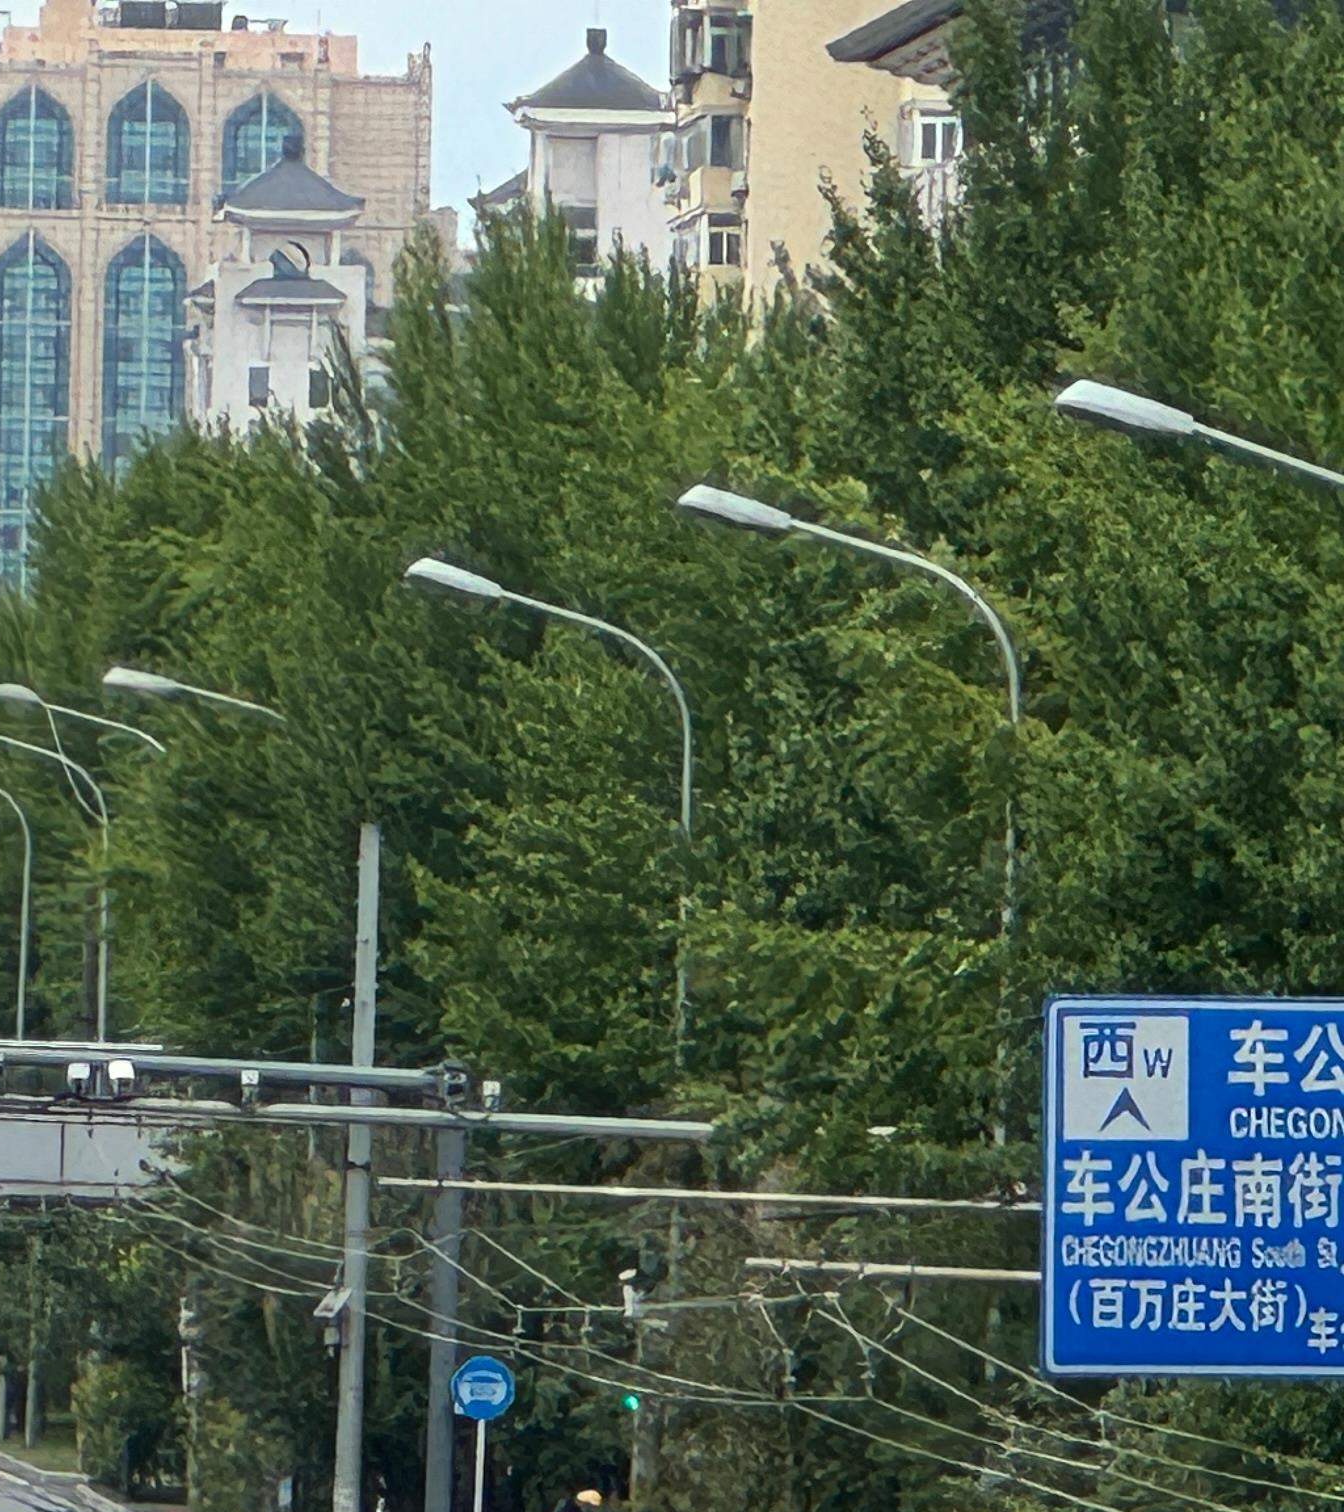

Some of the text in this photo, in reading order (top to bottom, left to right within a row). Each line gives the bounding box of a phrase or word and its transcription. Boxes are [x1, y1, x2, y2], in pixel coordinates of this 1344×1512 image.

[1079, 1021, 1173, 1079] 西 W
[1061, 1148, 1343, 1229] 车公庄南街
[1061, 1235, 1241, 1268] CHEGONGZHUANG
[1307, 1306, 1344, 1355] 车
